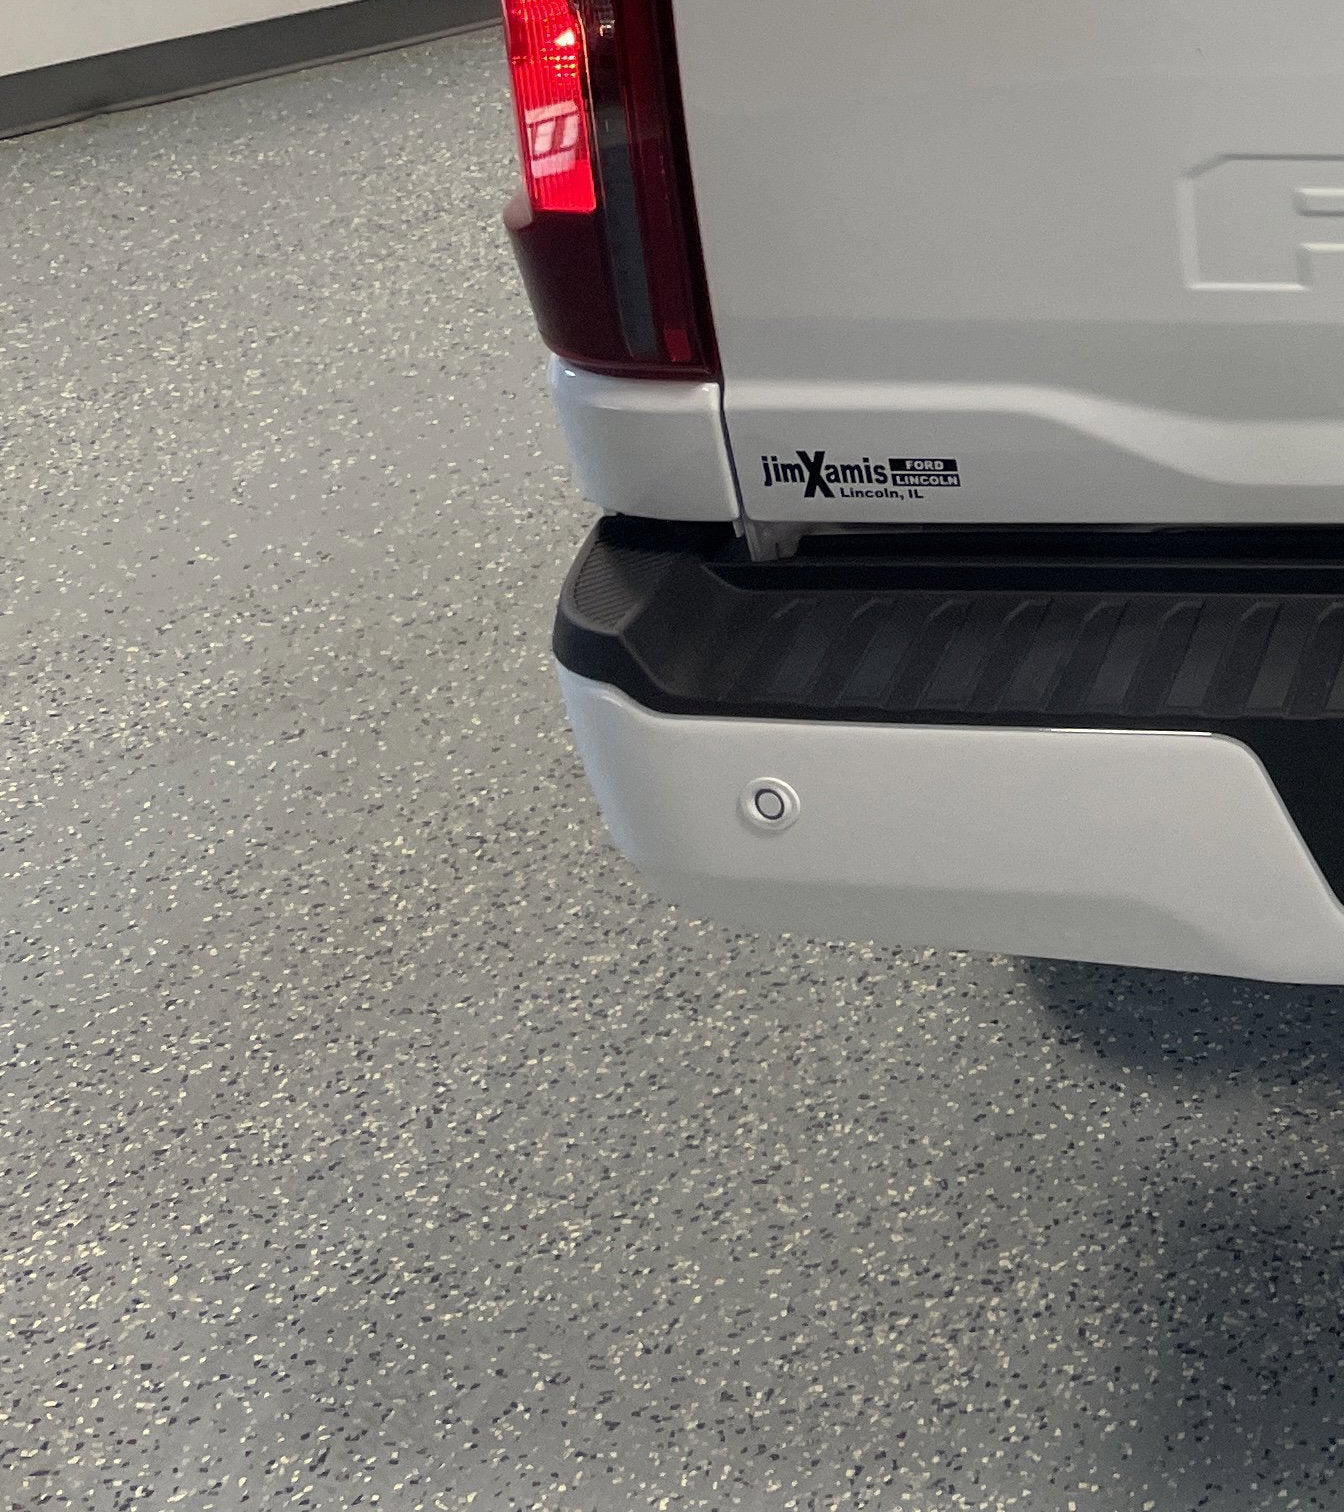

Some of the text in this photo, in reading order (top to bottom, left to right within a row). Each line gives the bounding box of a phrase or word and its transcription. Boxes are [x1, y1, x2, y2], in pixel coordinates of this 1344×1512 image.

[905, 460, 944, 471] FORD
[895, 474, 959, 486] LINCOLN
[840, 487, 924, 500] Lincoln, IL
